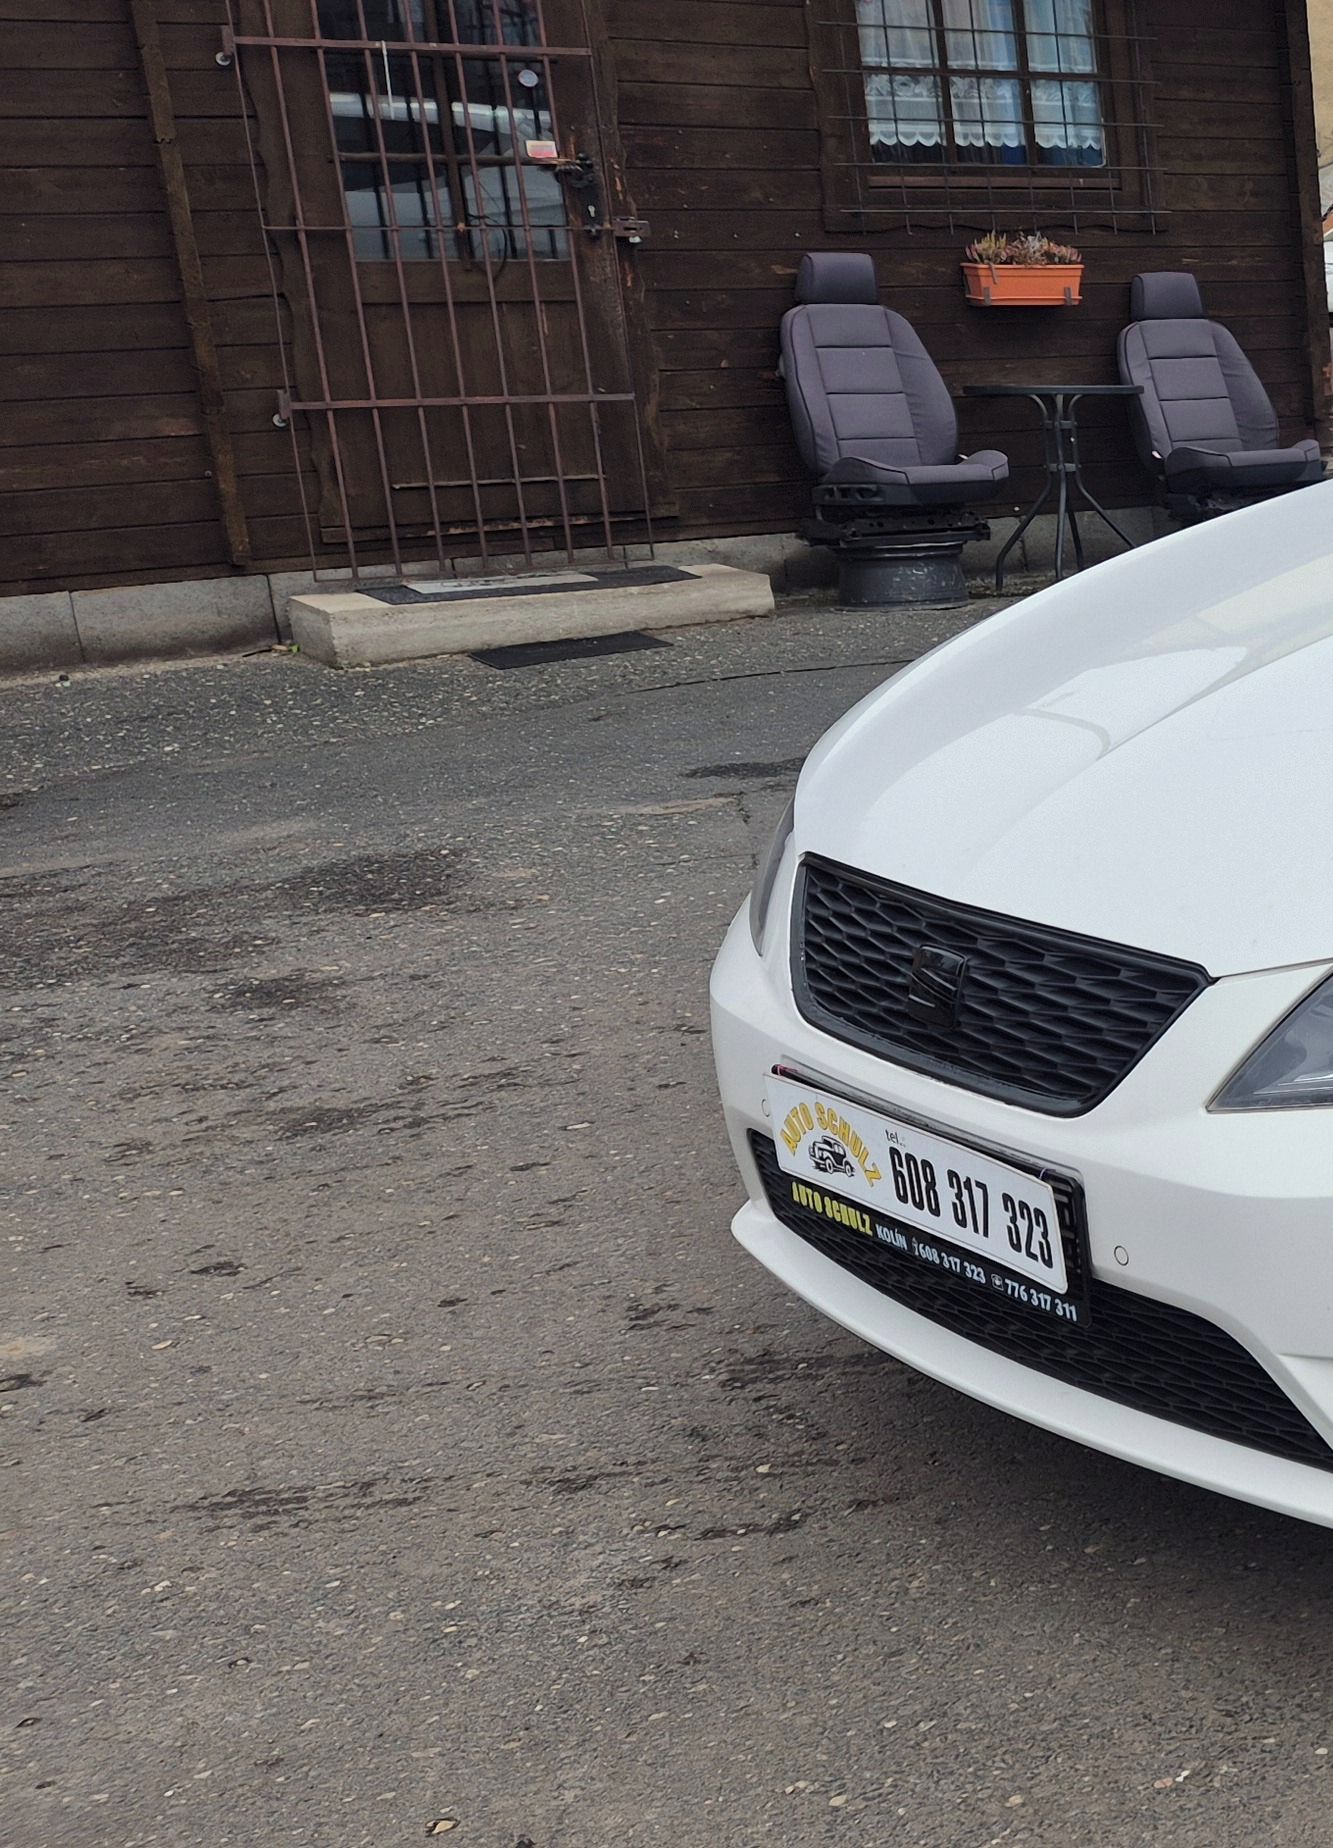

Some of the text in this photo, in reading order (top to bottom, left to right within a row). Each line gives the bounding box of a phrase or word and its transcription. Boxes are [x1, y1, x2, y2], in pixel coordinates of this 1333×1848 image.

[779, 1101, 883, 1188] AUTO SCHULZ
[791, 1181, 1077, 1322] AUTO SCHULZ KOLÍN 608 317 323 776 317 311
[889, 1146, 1054, 1269] 608 317 323
